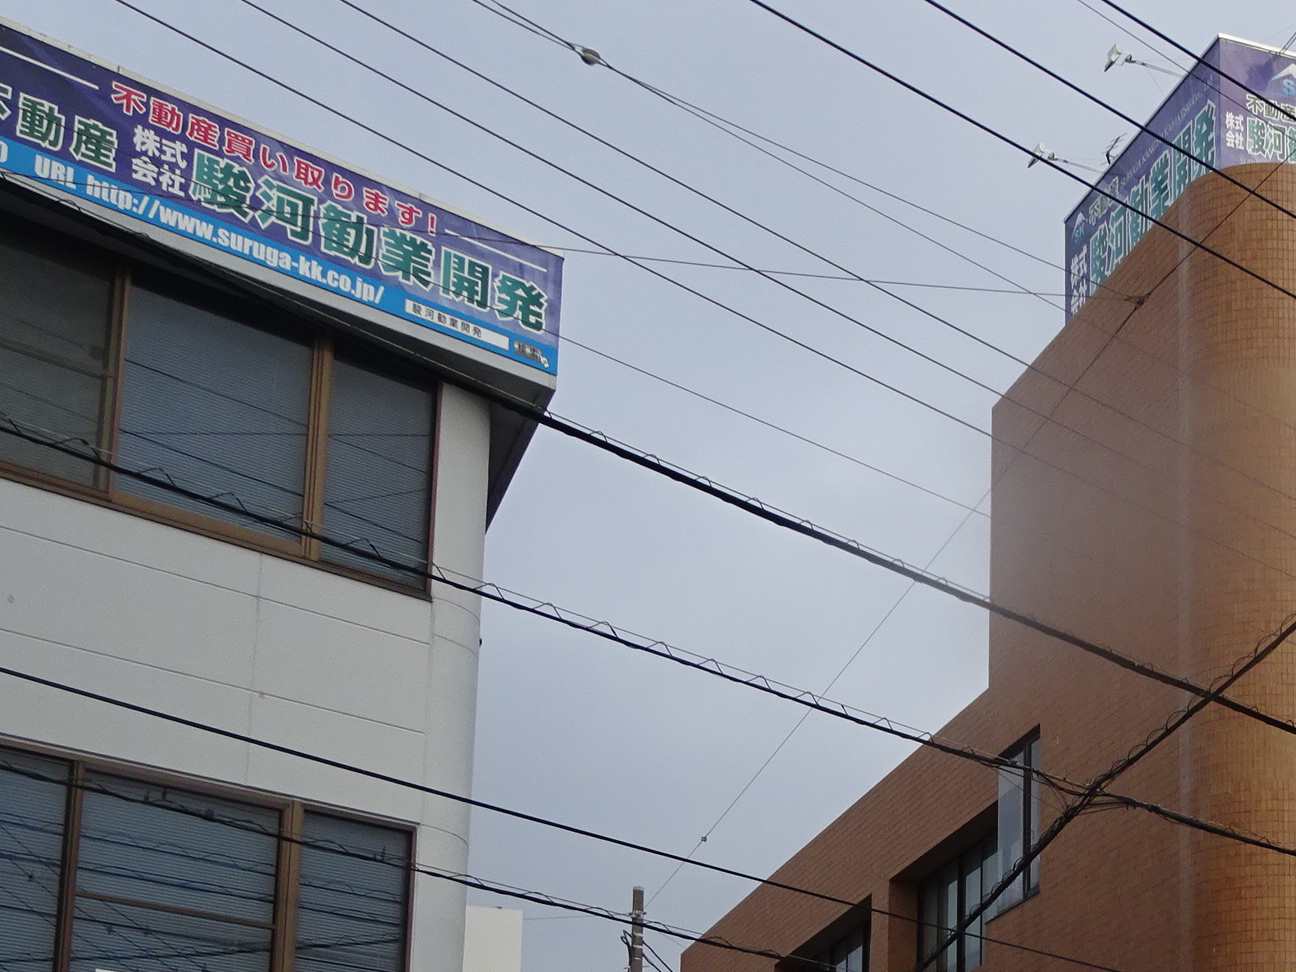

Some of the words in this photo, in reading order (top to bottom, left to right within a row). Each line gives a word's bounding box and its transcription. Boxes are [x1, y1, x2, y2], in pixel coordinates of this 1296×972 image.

[0, 83, 118, 172] 動産
[34, 154, 77, 190] URL
[86, 172, 385, 305] http://www.suruga-kk.co.jp/
[190, 148, 548, 333] 駿河勧業開発
